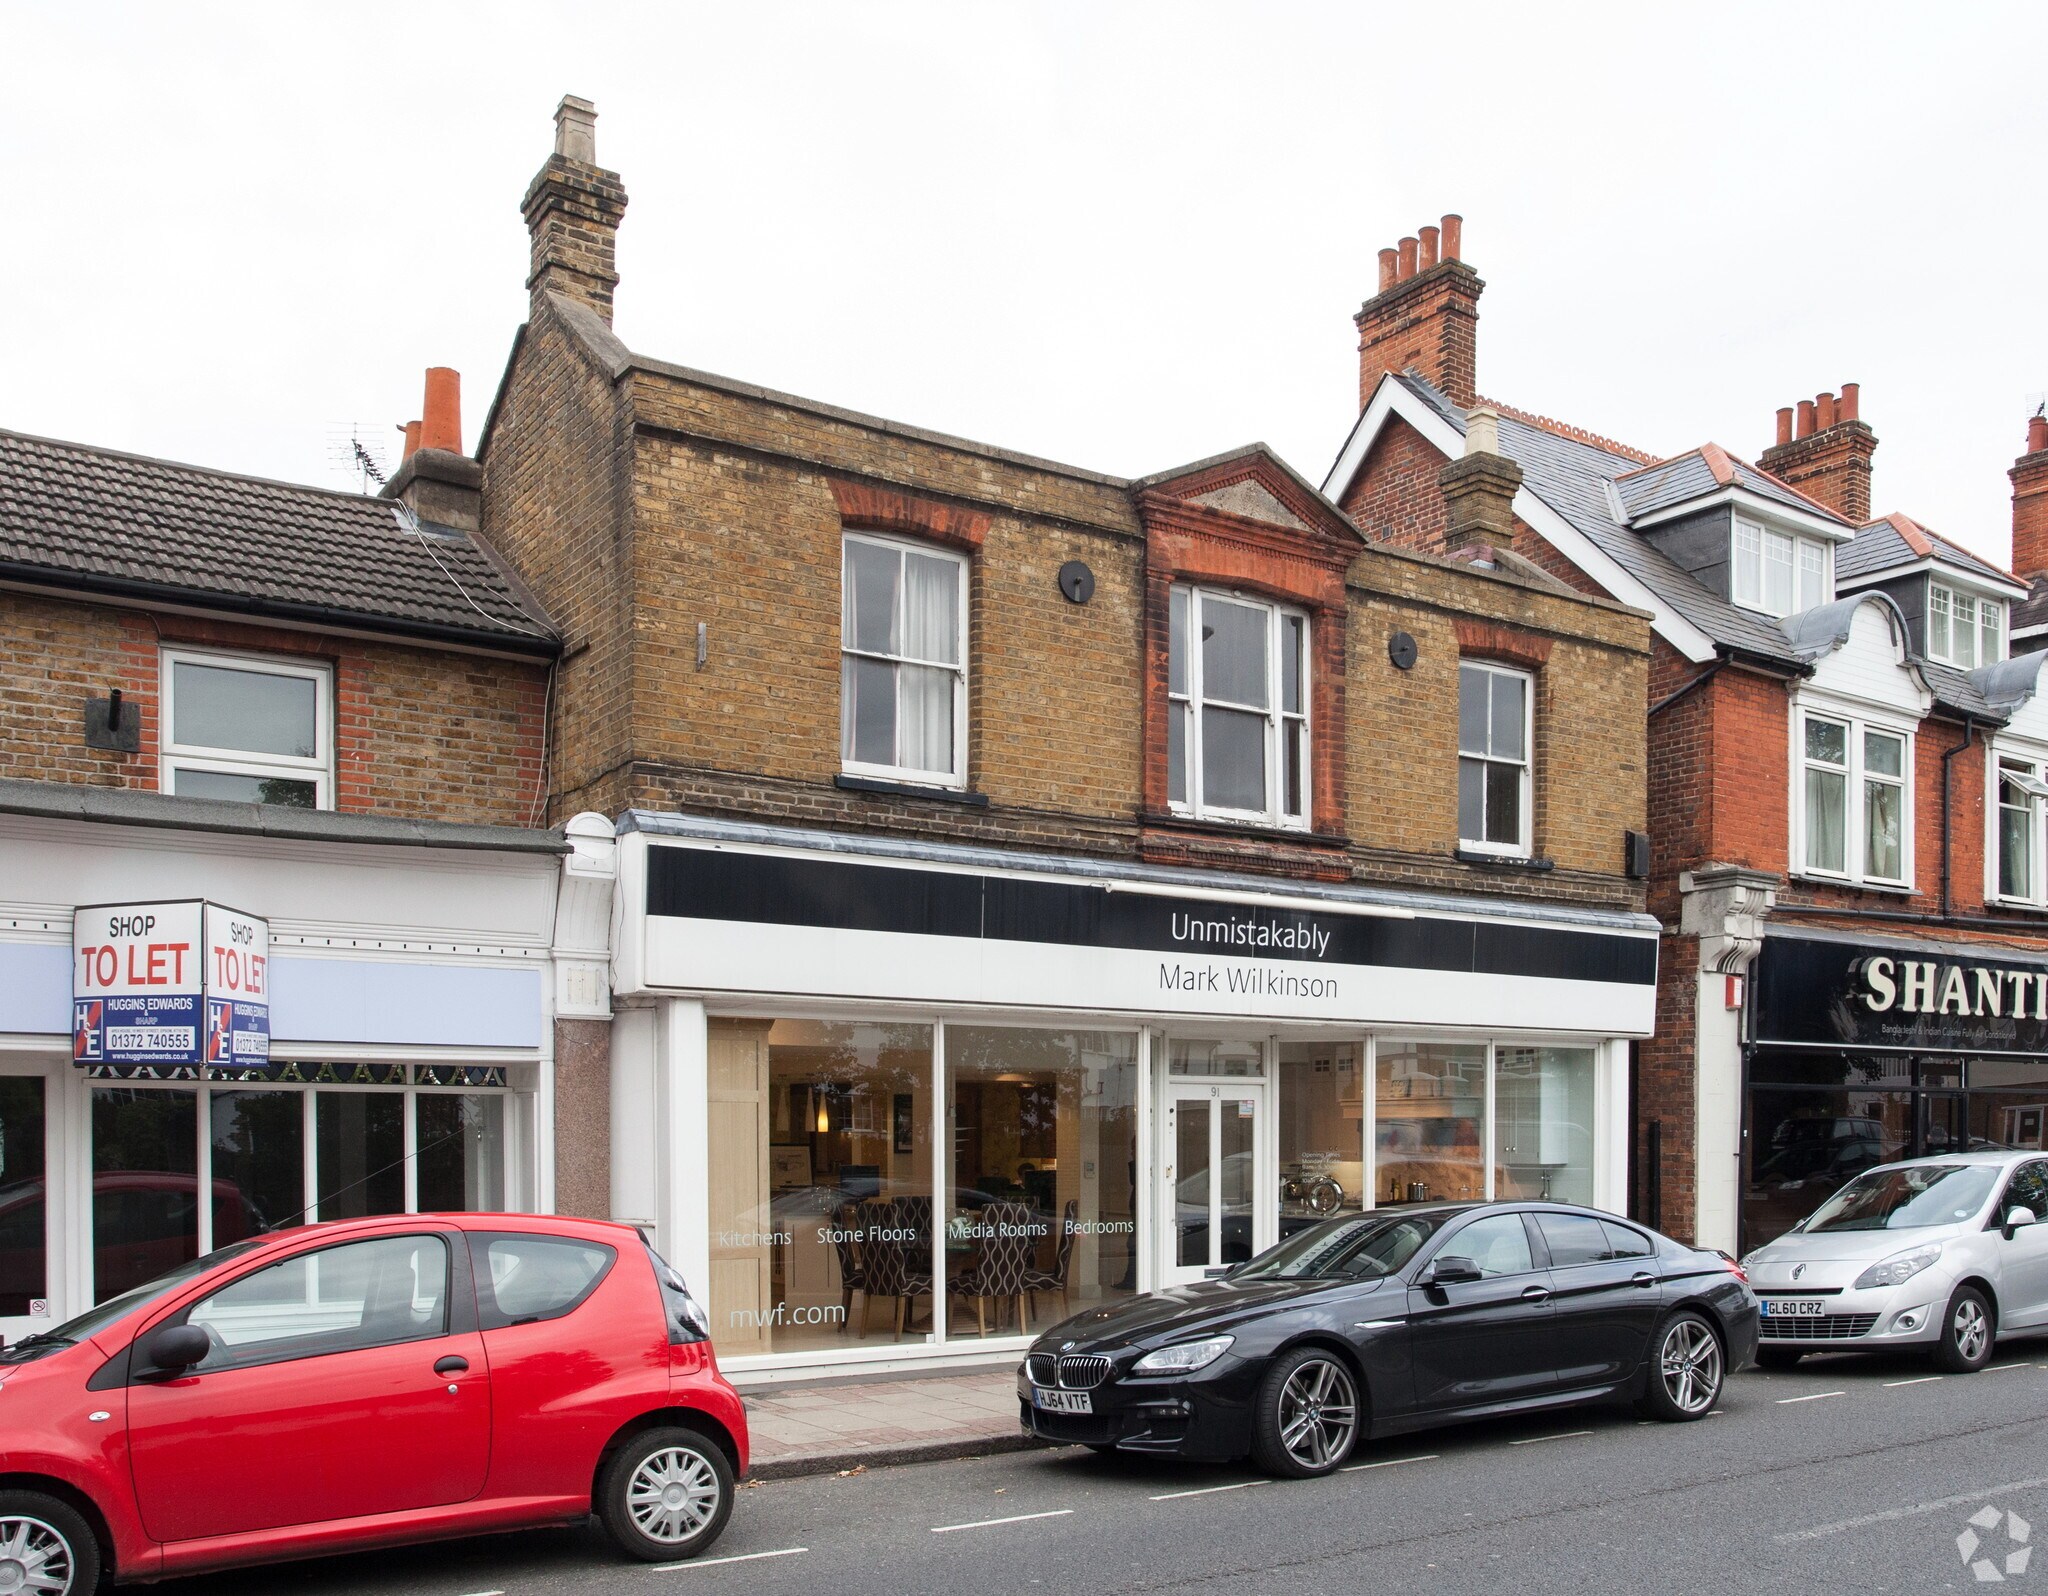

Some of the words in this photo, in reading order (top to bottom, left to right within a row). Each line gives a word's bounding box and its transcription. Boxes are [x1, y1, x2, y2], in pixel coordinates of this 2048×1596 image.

[109, 915, 156, 938] SHOP
[231, 921, 253, 946] SHOP
[1172, 912, 1330, 957] Unmistakably
[82, 945, 118, 987] TO
[128, 943, 189, 986] LET
[214, 946, 239, 991] TO
[243, 952, 266, 995] LET
[1160, 963, 1219, 992] Mark
[1227, 967, 1338, 998] Wilkinson
[1865, 956, 2047, 1020] SHANTI
[108, 998, 146, 1011] HUGGINS
[147, 997, 193, 1011] EDWARDS
[111, 1033, 143, 1048] 01372
[148, 1033, 190, 1048] 740555
[112, 1052, 189, 1061] www.hugginsedwards.co.uk
[1211, 1086, 1220, 1097] 91
[719, 1229, 792, 1248] Kitchens
[817, 1227, 864, 1244] Stone
[869, 1225, 916, 1242] Floors
[949, 1221, 994, 1239] Media
[999, 1222, 1048, 1237] Rooms
[1065, 1219, 1134, 1235] Bedrooms
[730, 1302, 846, 1329] mwf.com
[1768, 1302, 1797, 1315] GL60
[1799, 1302, 1822, 1315] CRZ
[1039, 1390, 1064, 1409] HJ64
[1065, 1393, 1088, 1410] VTF
